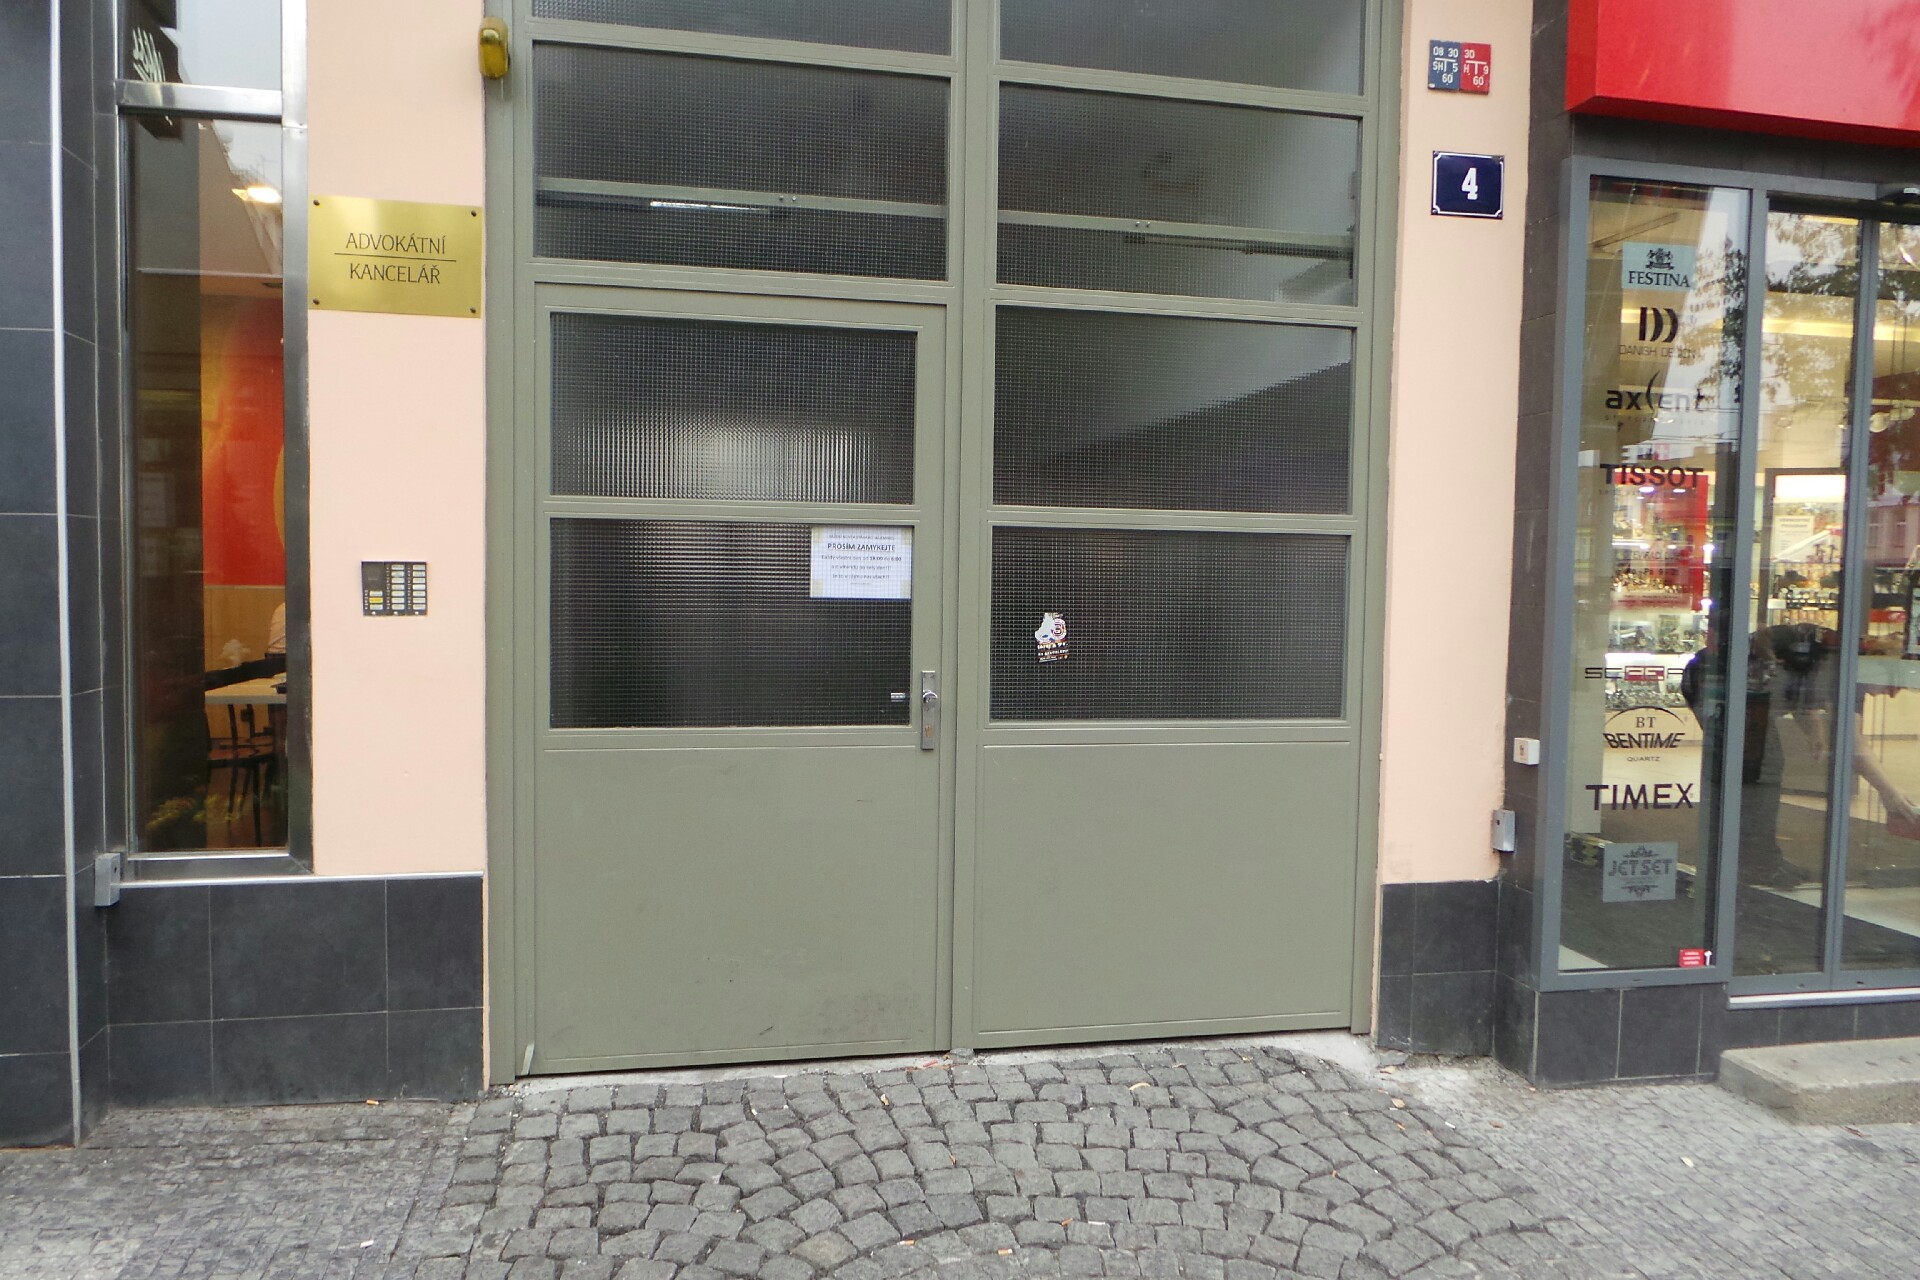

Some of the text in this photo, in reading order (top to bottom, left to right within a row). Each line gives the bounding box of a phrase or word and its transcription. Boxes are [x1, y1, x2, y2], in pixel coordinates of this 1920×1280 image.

[1448, 48, 1459, 58] 30
[1464, 49, 1476, 59] 30
[1461, 167, 1478, 200] 4
[345, 232, 447, 255] ADVOKÁTNÍ
[349, 262, 441, 285] KANCELÁŘ
[1628, 270, 1691, 288] FESTINA
[1600, 463, 1704, 489] TISSOT
[827, 542, 896, 552] PROSÍM ZAMYKEJTE
[1636, 716, 1657, 729] BT
[1602, 732, 1686, 749] BENTIME
[1585, 783, 1694, 811] TIMEX
